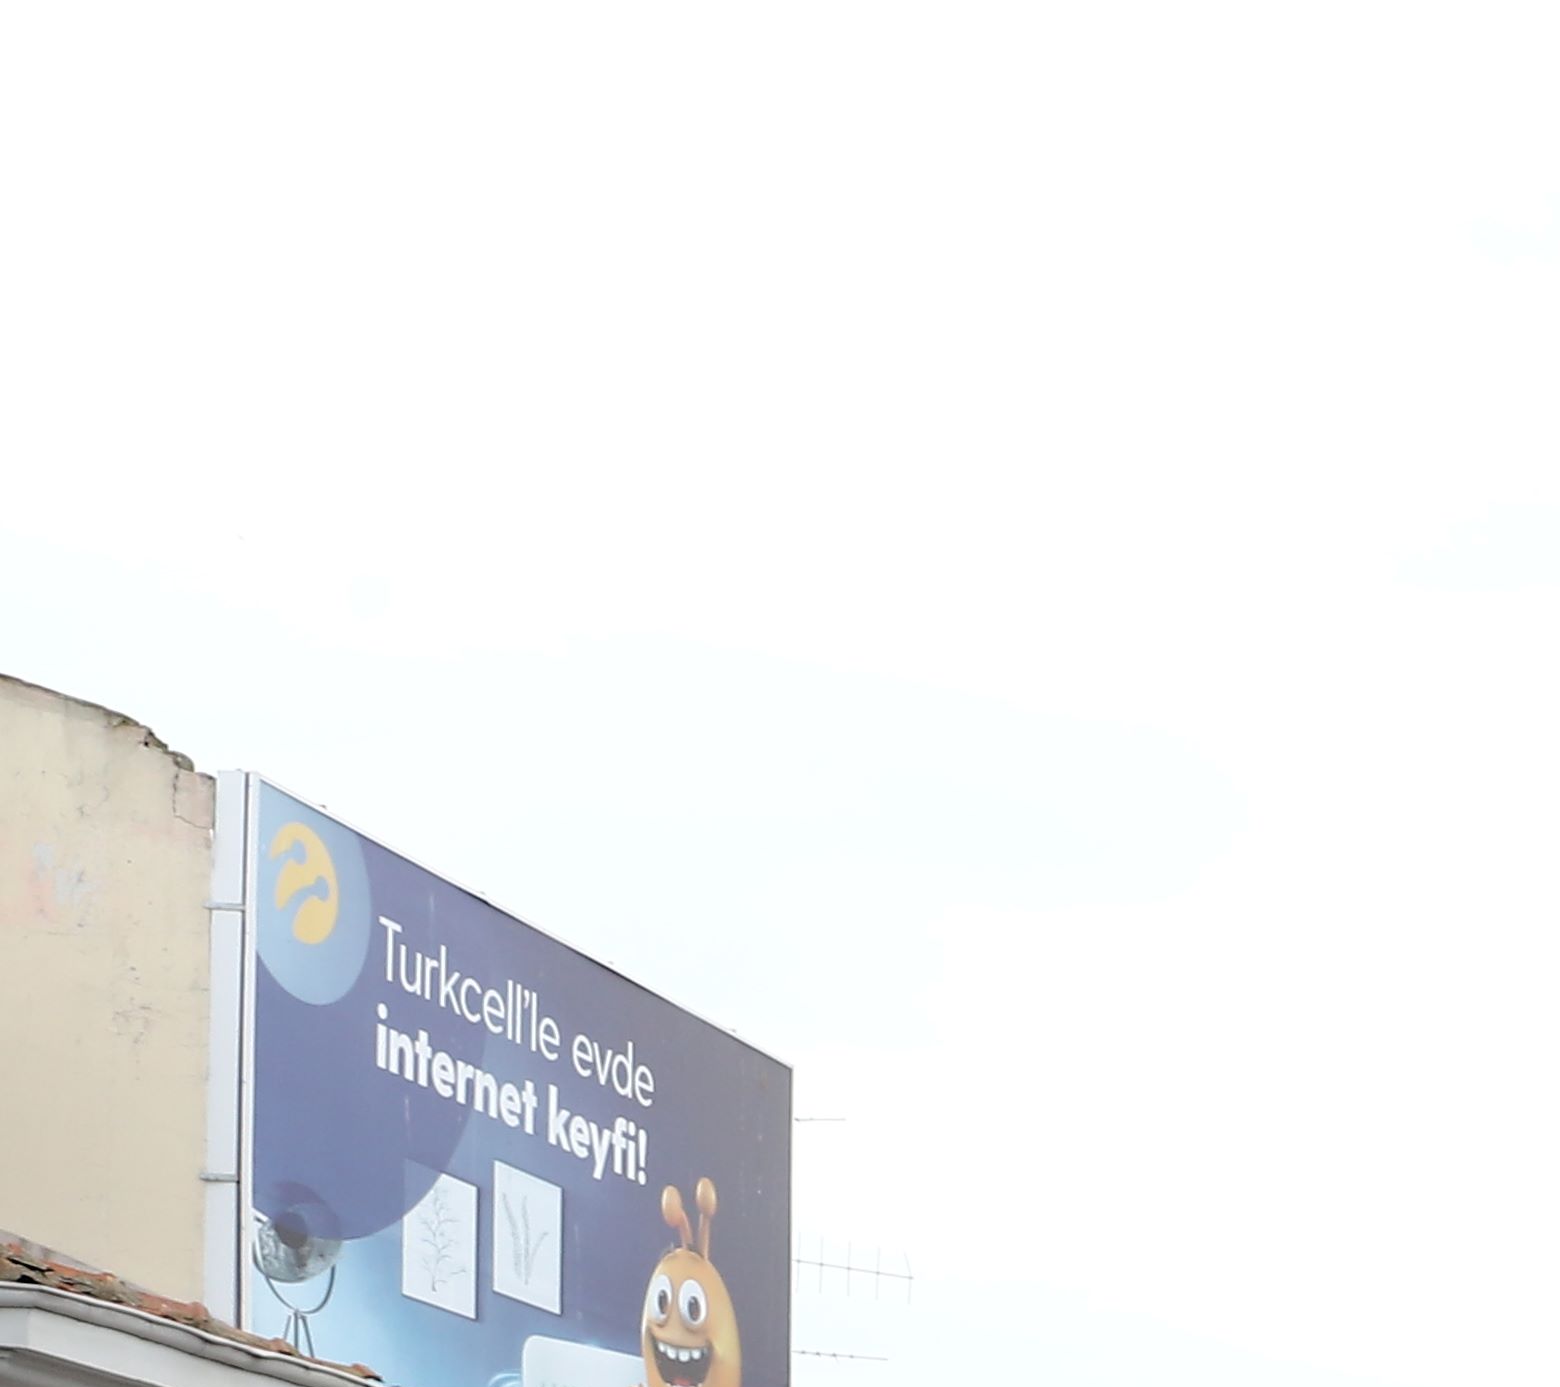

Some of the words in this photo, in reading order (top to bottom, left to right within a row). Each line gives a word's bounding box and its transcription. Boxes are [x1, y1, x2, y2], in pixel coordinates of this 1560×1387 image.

[375, 1004, 536, 1135] internet
[547, 1085, 648, 1185] keyfi!
[572, 1027, 654, 1107] evde
